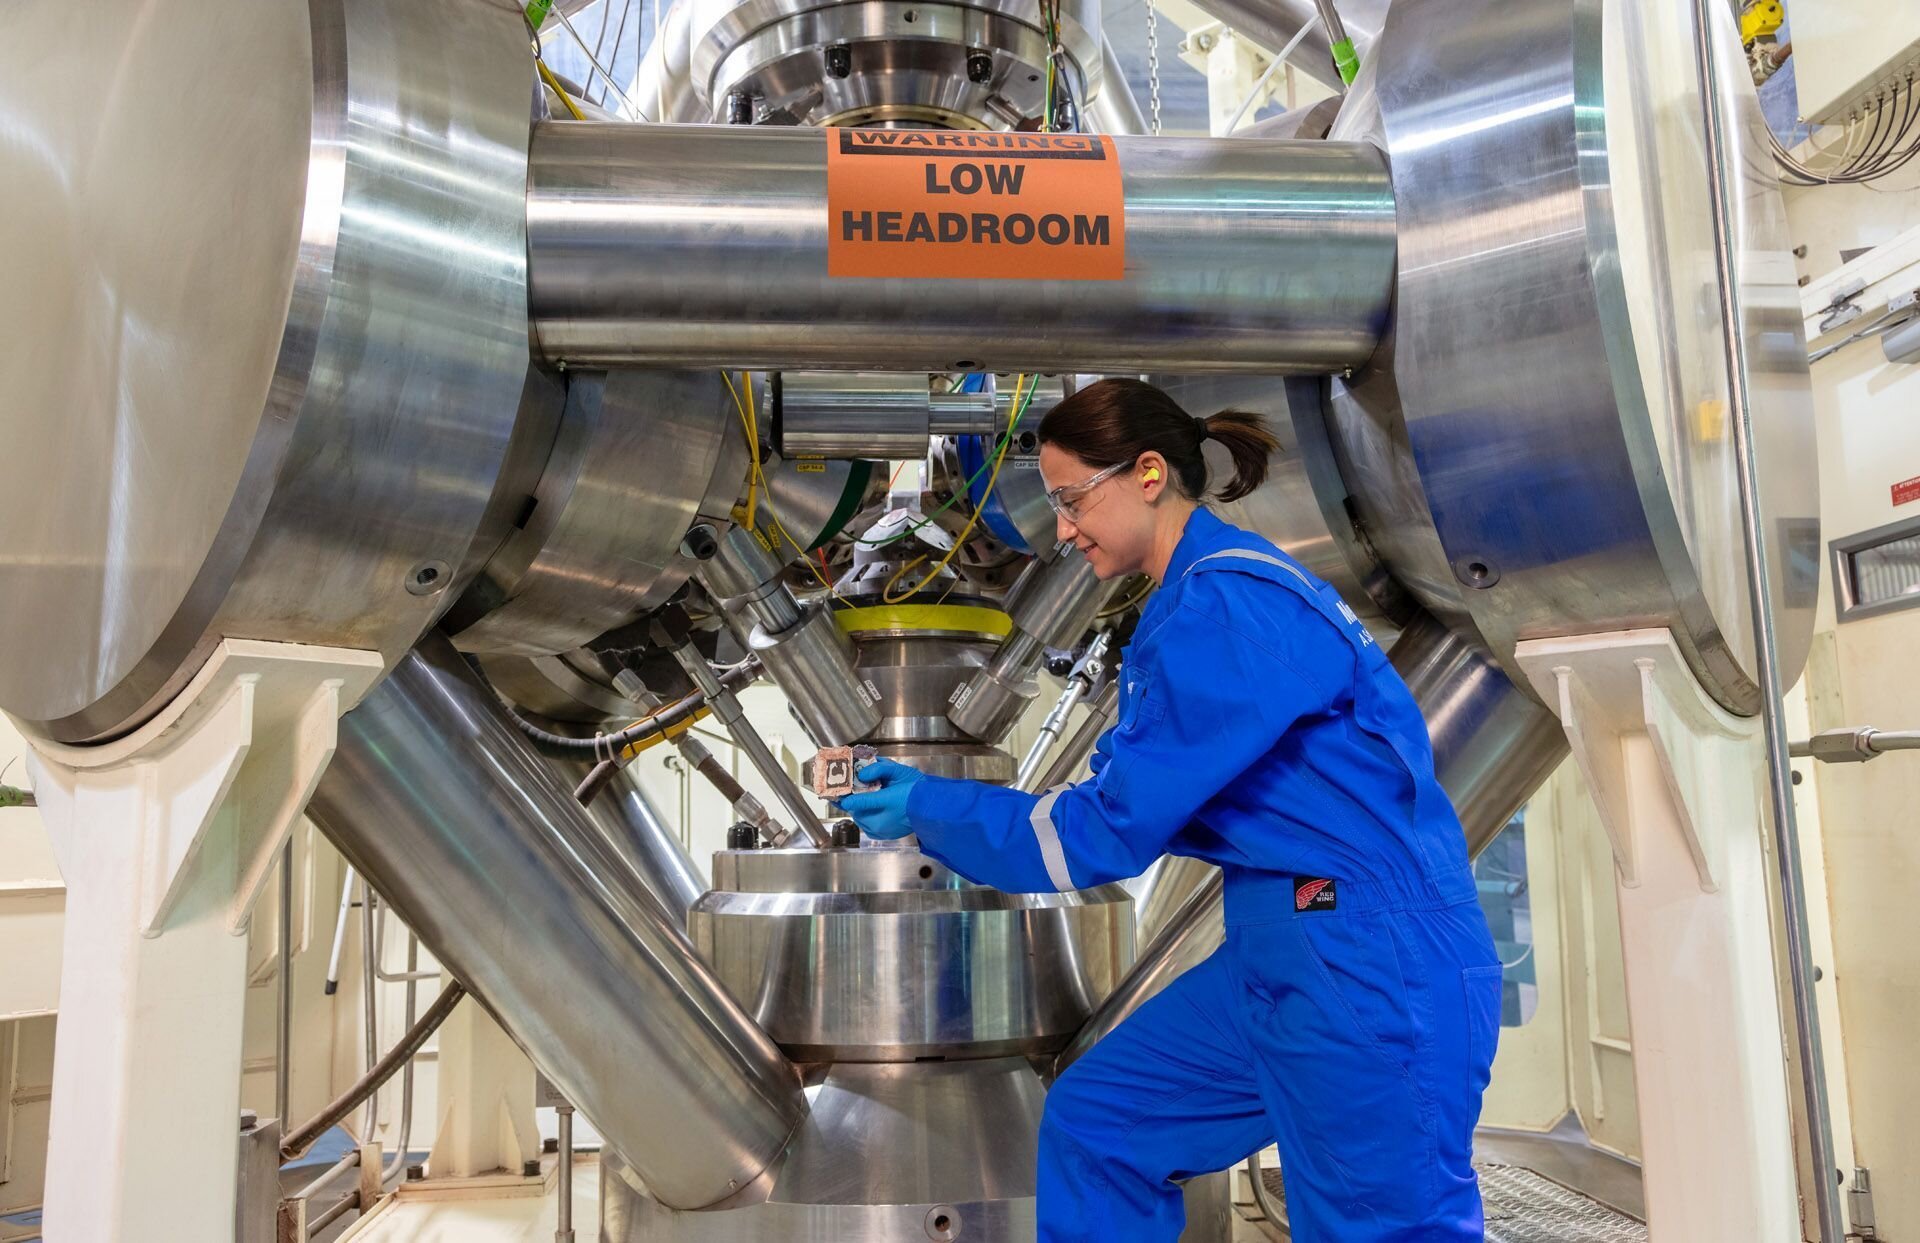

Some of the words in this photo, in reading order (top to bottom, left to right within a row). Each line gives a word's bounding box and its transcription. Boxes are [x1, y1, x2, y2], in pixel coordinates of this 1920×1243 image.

[855, 132, 1086, 149] WARNING
[925, 163, 1026, 195] LOW
[842, 211, 1110, 246] HEADROOM
